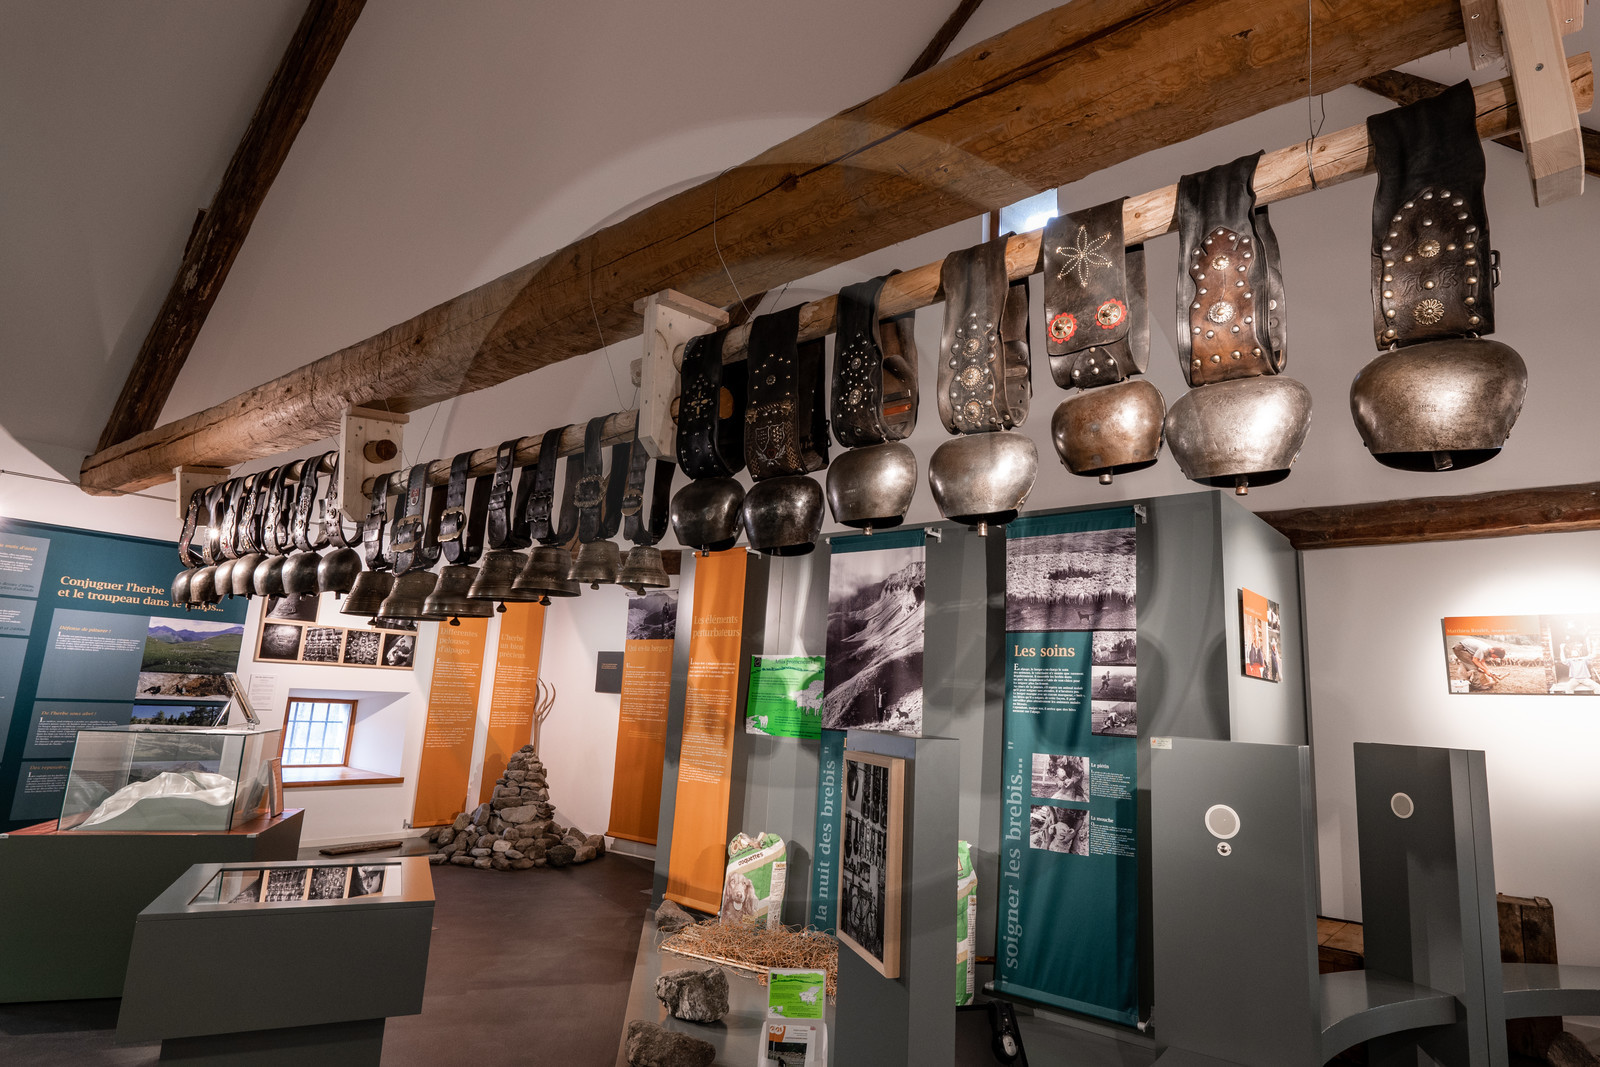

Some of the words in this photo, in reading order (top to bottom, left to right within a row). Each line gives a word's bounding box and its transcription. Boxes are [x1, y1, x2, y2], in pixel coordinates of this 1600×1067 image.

[57, 589, 70, 598] et
[73, 588, 85, 599] le
[87, 592, 140, 604] troupeau
[143, 597, 170, 607] dans
[60, 575, 124, 591] Conjuguer
[126, 583, 165, 595] l'herbe
[693, 616, 705, 624] Les
[693, 627, 740, 638] perturbateurs
[1014, 645, 1036, 657] Les
[1040, 644, 1075, 657] soins
[821, 760, 836, 817] brebis
[1006, 758, 1023, 841] brebis...
[819, 823, 832, 855] des
[1005, 848, 1021, 878] les
[818, 860, 830, 899] nuit
[815, 905, 828, 922] la
[1003, 885, 1022, 969] soigner
